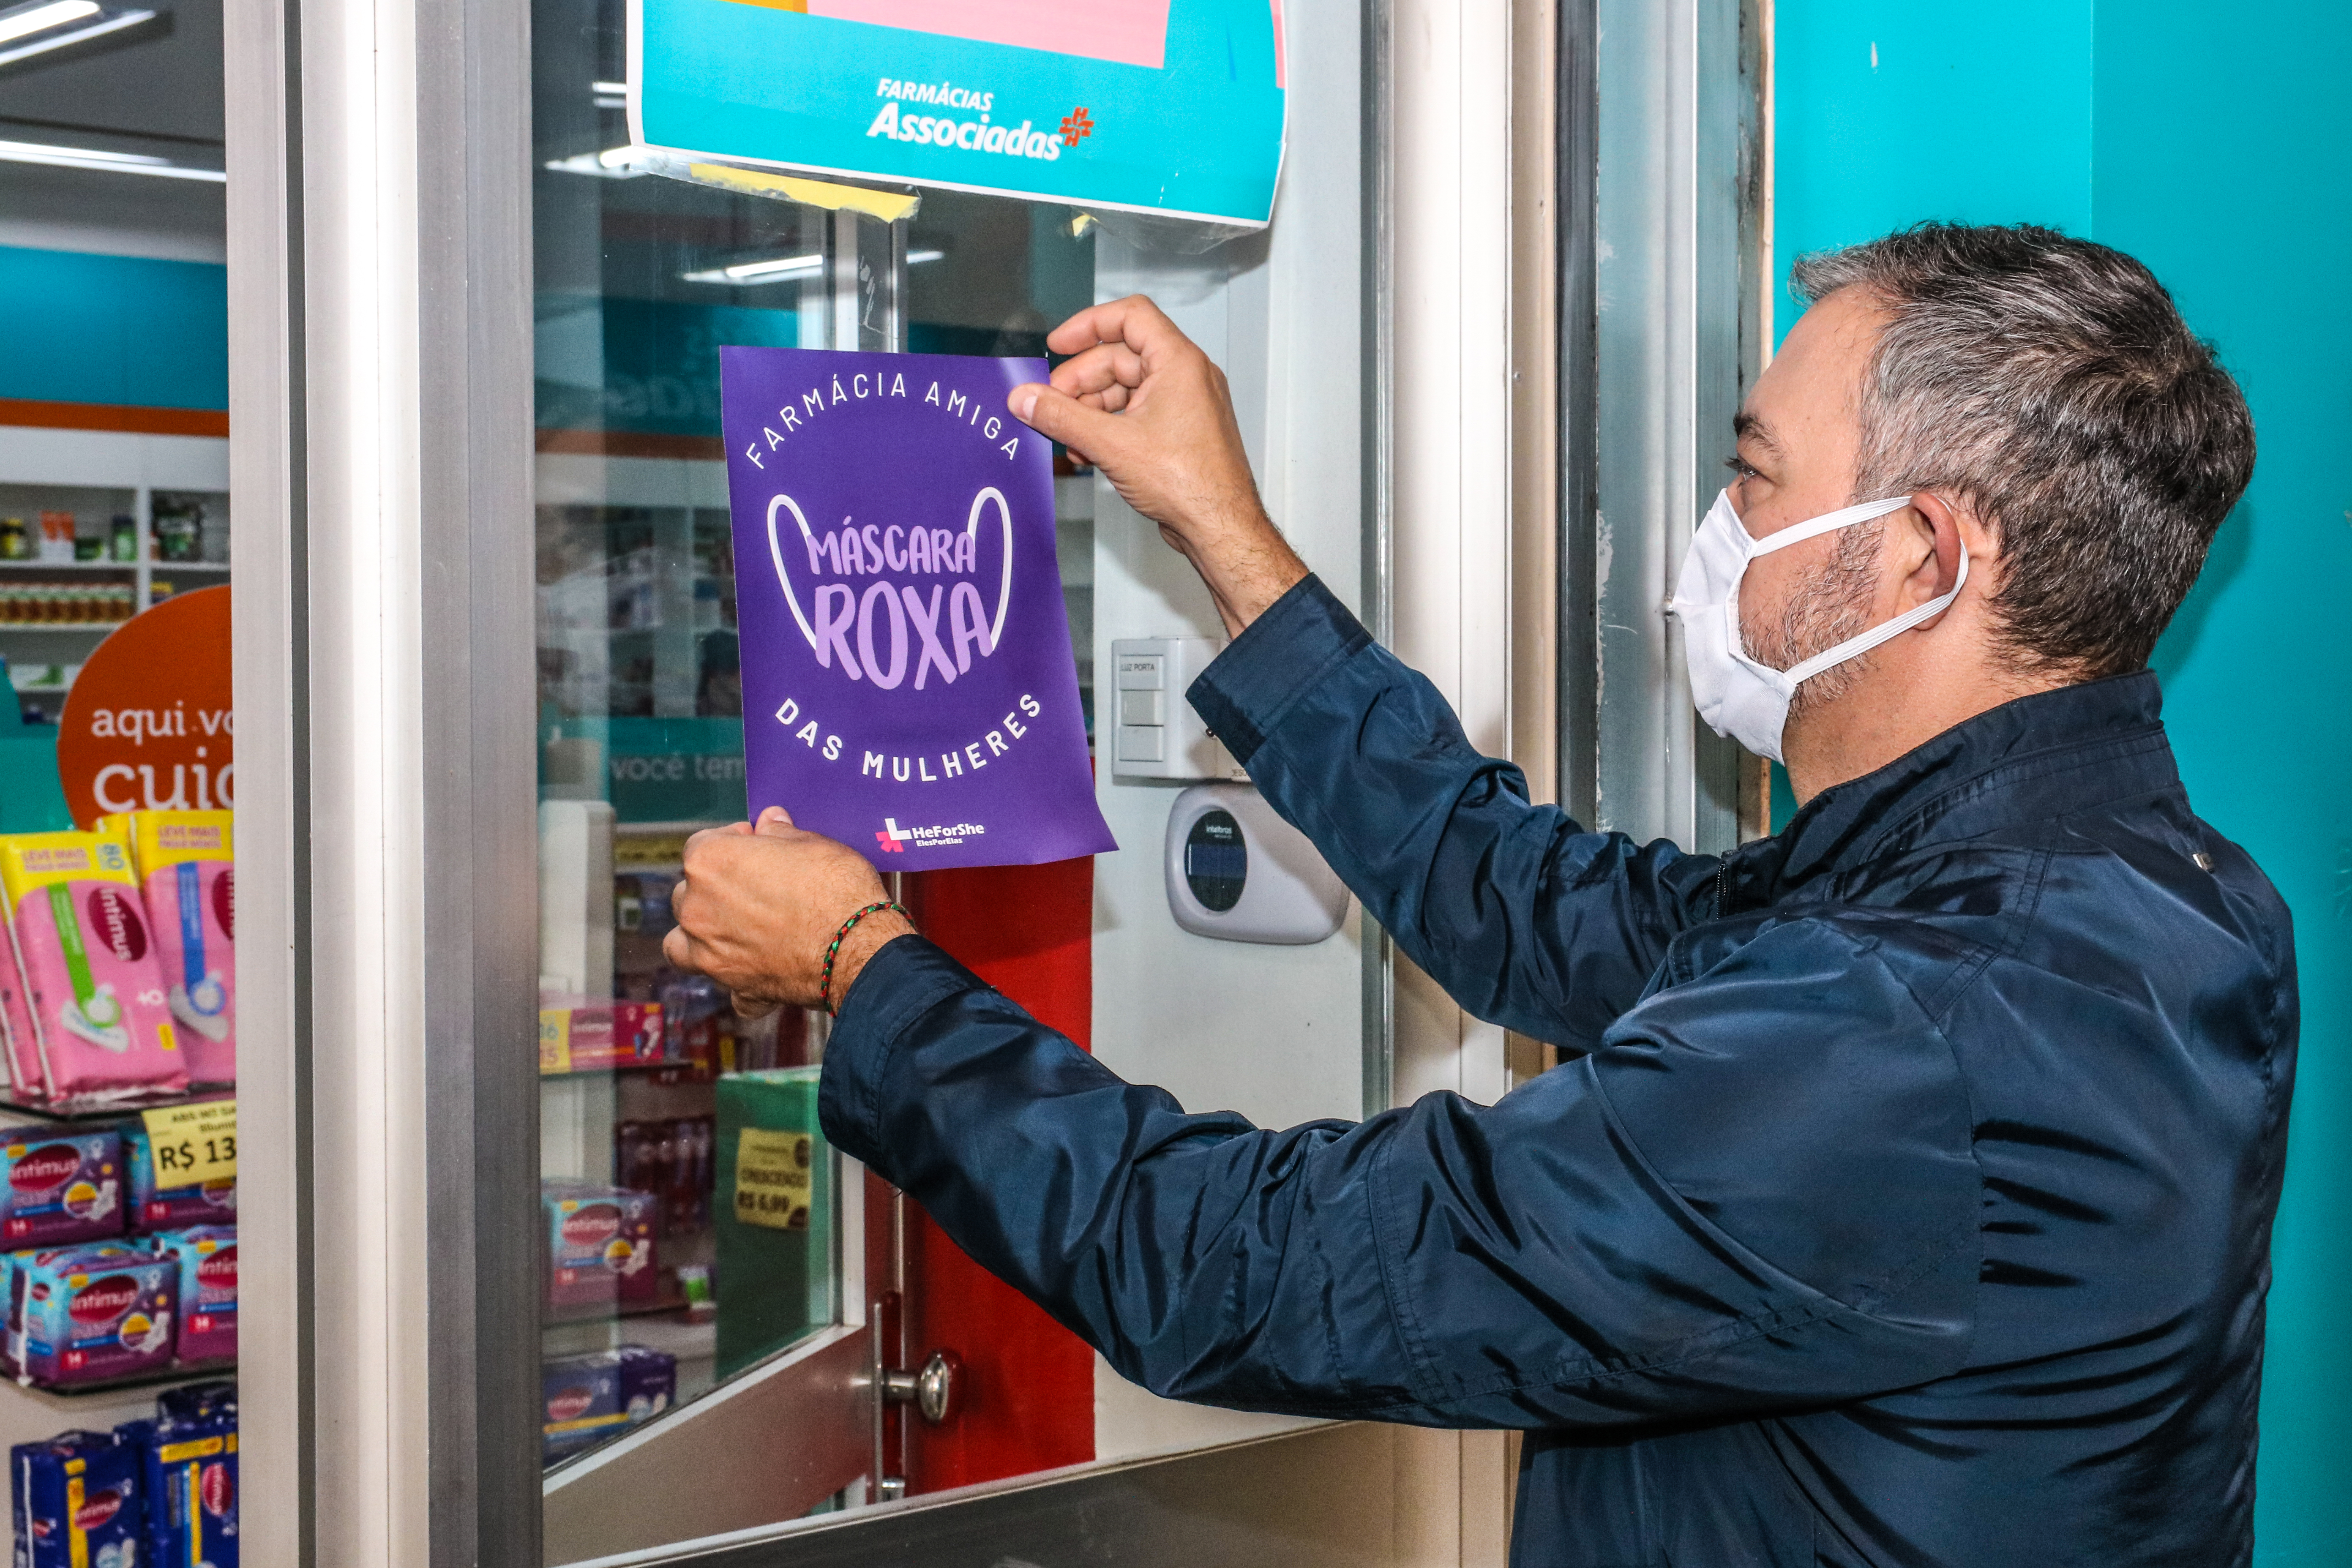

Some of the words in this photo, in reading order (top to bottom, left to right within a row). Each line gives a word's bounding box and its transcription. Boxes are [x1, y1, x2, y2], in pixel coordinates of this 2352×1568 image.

[877, 78, 994, 112] FARMÁCIAS
[867, 102, 1063, 161] Associadas
[745, 372, 906, 469] FARMÁCIA
[925, 381, 1019, 461] AMIGA
[806, 515, 977, 575] MÁSCARA
[814, 580, 996, 690] ROXA
[1121, 663, 1132, 671] LUZ
[1134, 663, 1154, 671] PORTA
[91, 700, 187, 746] aqui
[775, 698, 843, 761] DAS
[862, 694, 1041, 782] MULHERES
[911, 823, 985, 839] HeForShe
[916, 837, 963, 847] ElesPorElas
[100, 887, 133, 961] intimus
[160, 1137, 196, 1170] R$
[205, 1137, 236, 1163] 13
